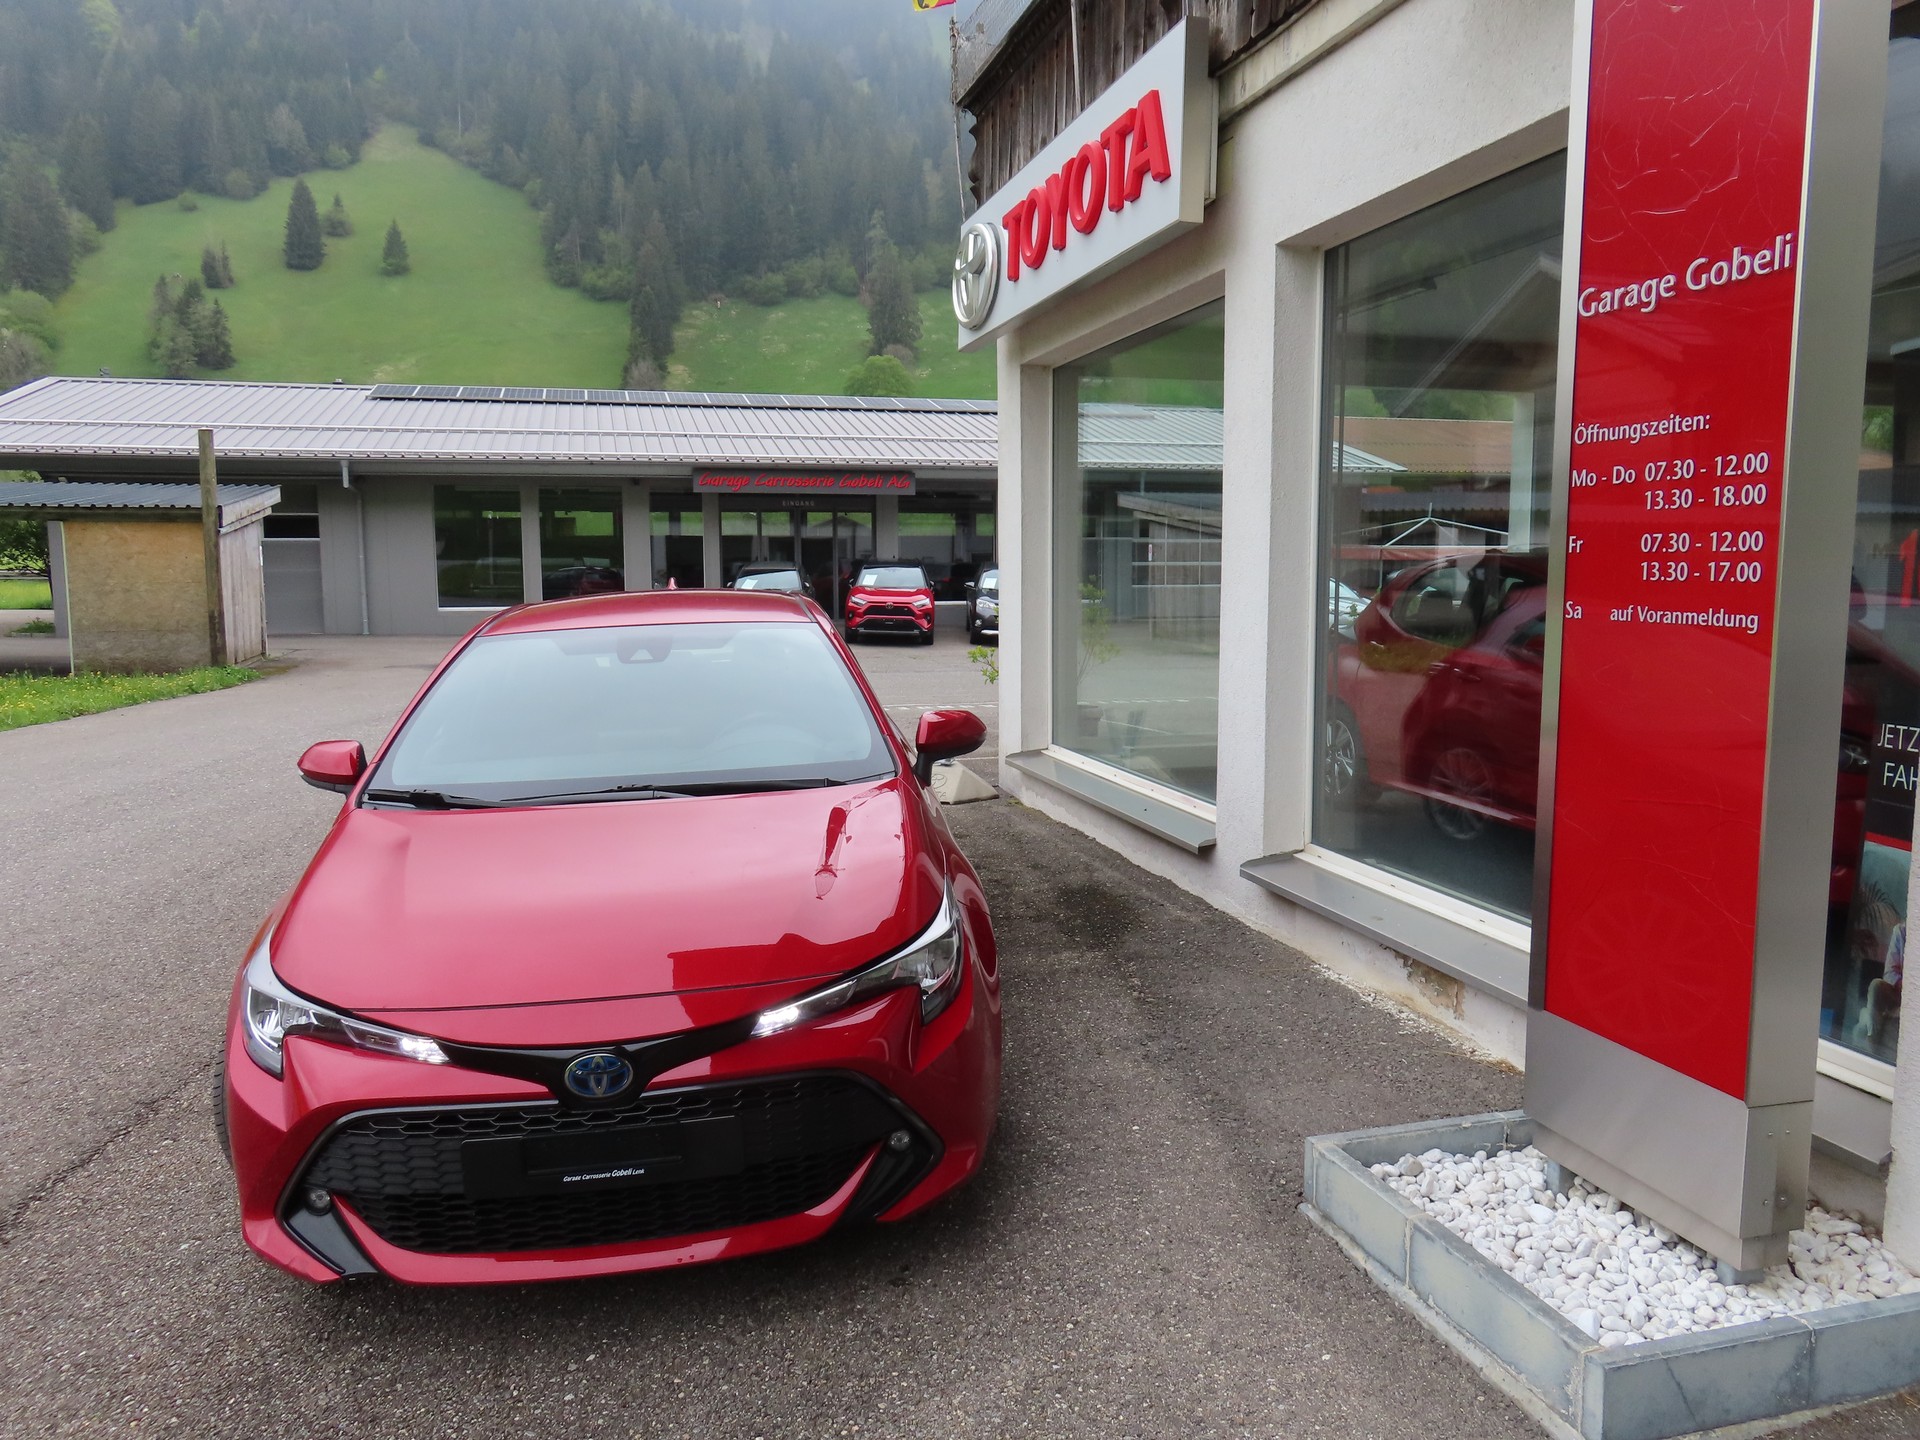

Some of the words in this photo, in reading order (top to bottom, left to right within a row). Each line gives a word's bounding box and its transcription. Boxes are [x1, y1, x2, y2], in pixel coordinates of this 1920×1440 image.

[1002, 89, 1171, 282] TOYOTA
[1578, 274, 1676, 317] Garage
[1685, 232, 1793, 291] Gobeli
[1574, 413, 1711, 444] Öffnungszeiten:
[698, 472, 750, 492] Garage
[755, 473, 835, 487] Carrosserie
[839, 474, 884, 488] Gobeli
[887, 474, 911, 488] AG
[1572, 469, 1597, 487] Mo
[1612, 465, 1636, 485] Do
[1644, 458, 1695, 482] 07.30
[1714, 451, 1769, 477] 12.00
[1644, 488, 1693, 510] 13.30
[1712, 483, 1767, 507] 18.00
[1568, 535, 1584, 553] Fr
[1640, 532, 1690, 553] 07.30
[1709, 530, 1764, 552] 12.00
[1641, 561, 1689, 582] 13.30
[1707, 561, 1762, 583] 17.00
[1565, 600, 1582, 619] Sa
[1610, 604, 1634, 622] auf
[1637, 605, 1759, 634] Voranmeldung
[611, 1168, 632, 1177] Gobeli
